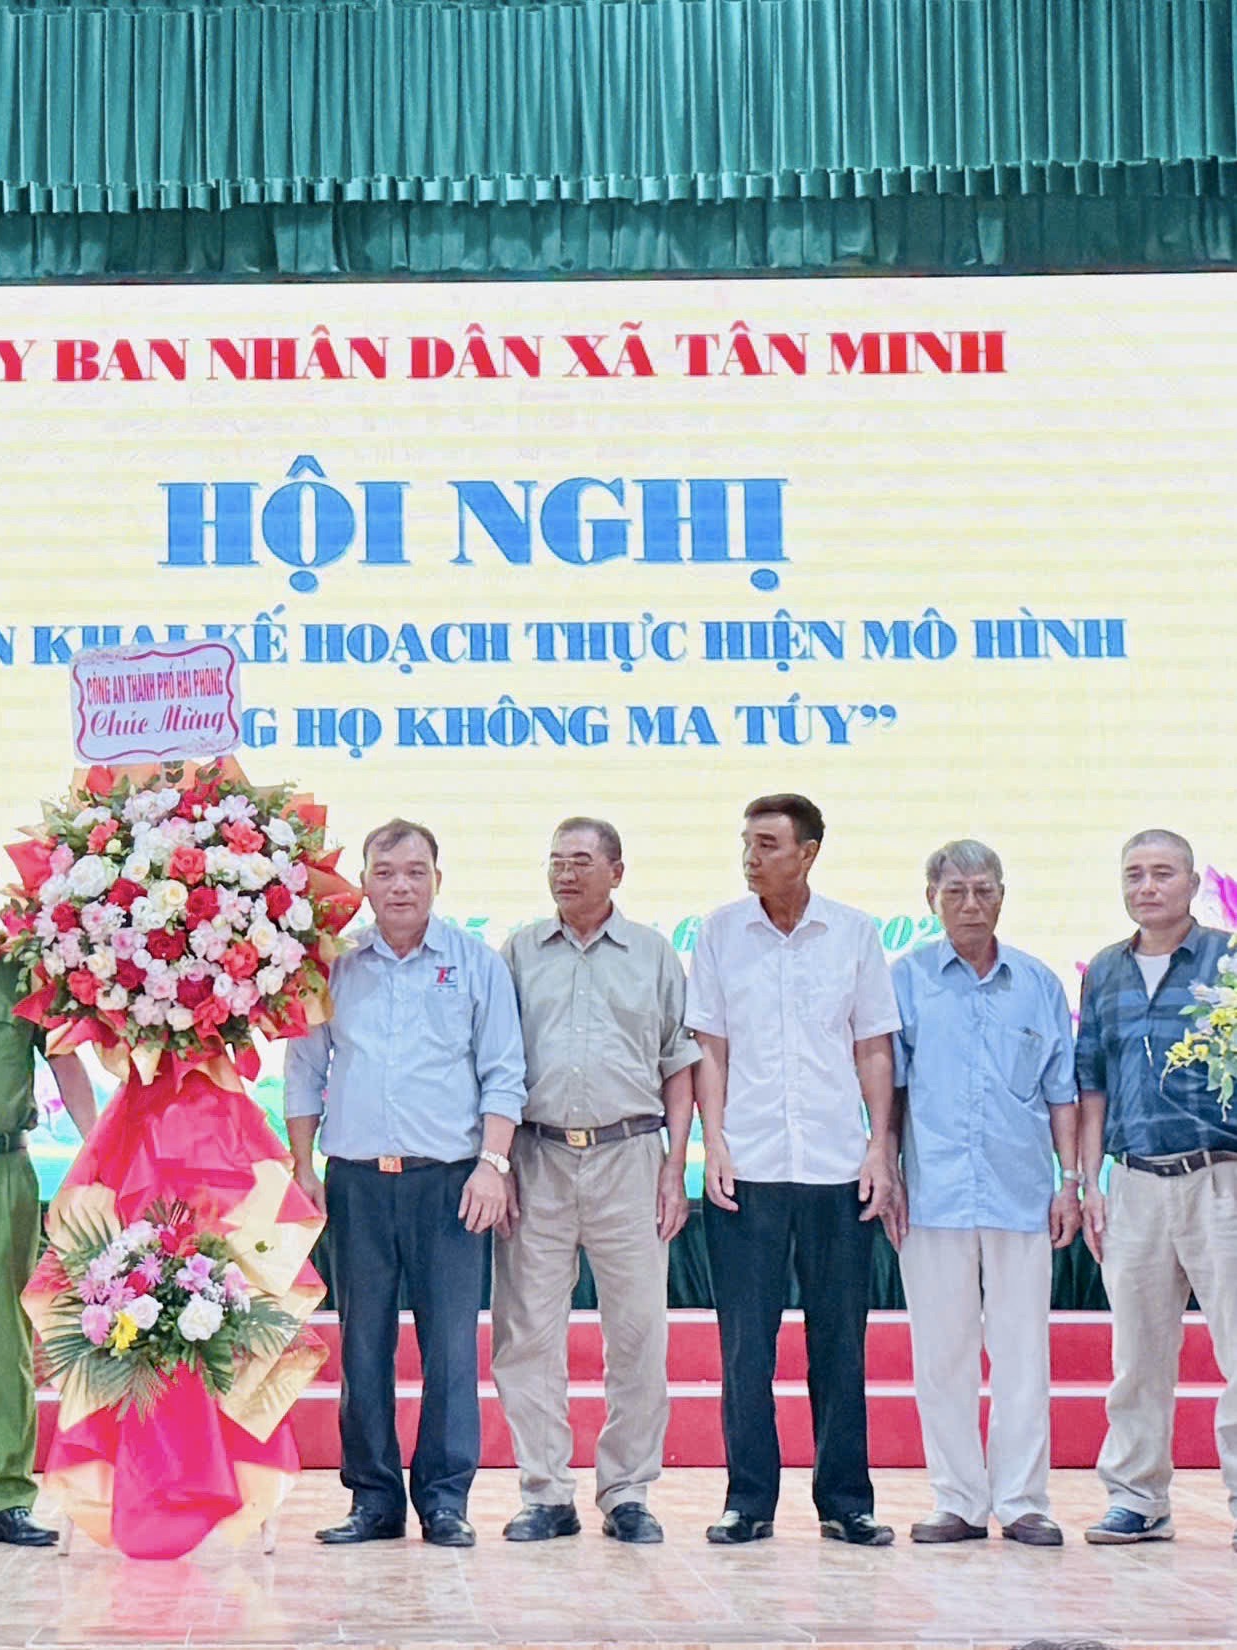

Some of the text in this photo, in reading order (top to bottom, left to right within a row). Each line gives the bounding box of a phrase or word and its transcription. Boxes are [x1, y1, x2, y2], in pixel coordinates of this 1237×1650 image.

[52, 337, 190, 383] BAN
[207, 323, 390, 382] NHÂN
[407, 322, 542, 381] DÂN
[563, 321, 660, 379] XÃ
[674, 320, 809, 378] TÂN
[827, 330, 1007, 376] MINH
[157, 453, 791, 594] HỘI NGHỊ
[303, 621, 513, 674] HOẠCH
[525, 612, 688, 673] THỰC
[701, 608, 846, 672] HIỆN
[861, 607, 959, 661] MÔ
[971, 606, 1129, 660] HÌNH
[86, 658, 224, 705] CÔNG AN THÀNH PHỐ HẢI PHÒNG
[90, 709, 149, 737] Chúc
[154, 704, 227, 735] Mừng
[294, 707, 384, 759] HỌ
[396, 694, 611, 749] KHÔNG
[626, 704, 722, 748] MA
